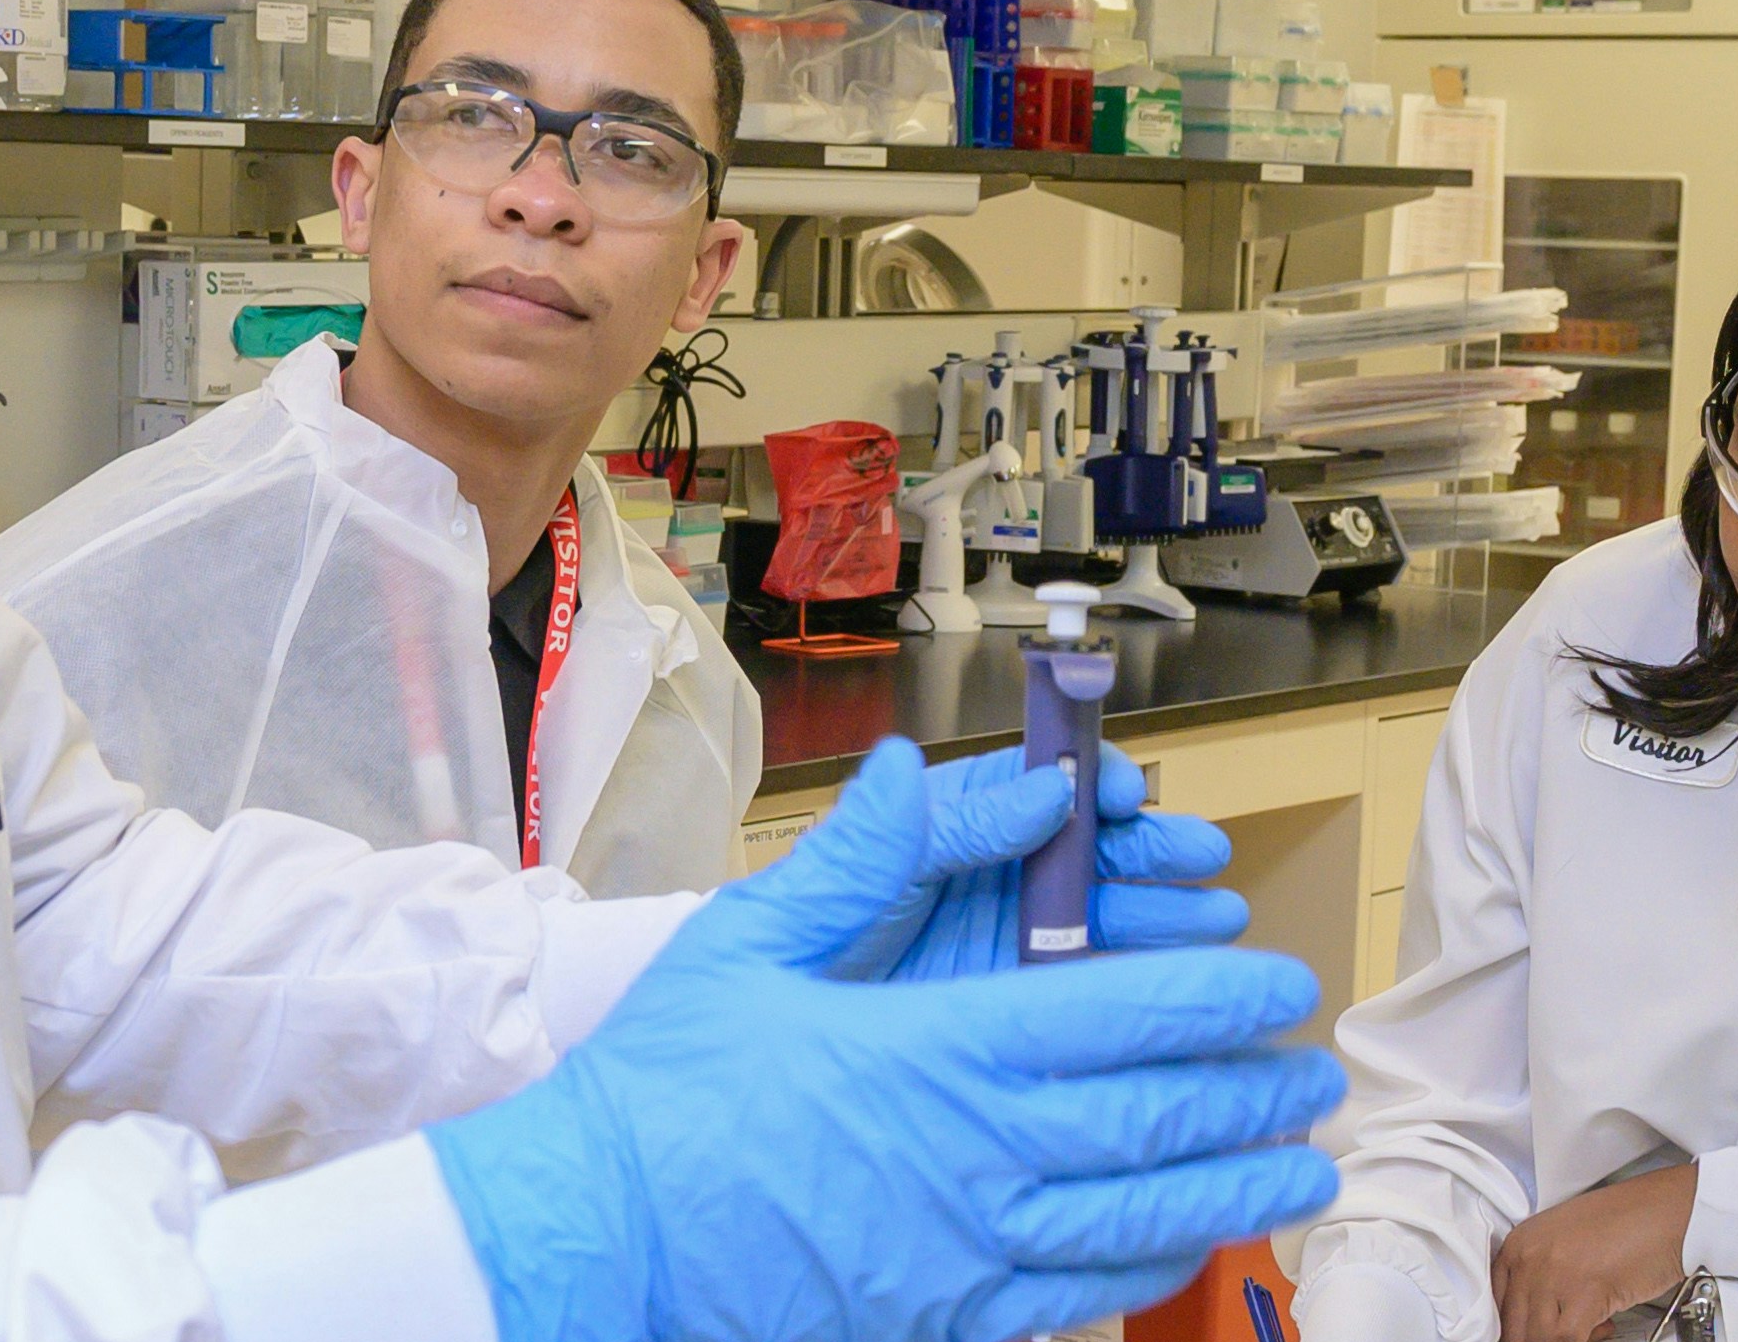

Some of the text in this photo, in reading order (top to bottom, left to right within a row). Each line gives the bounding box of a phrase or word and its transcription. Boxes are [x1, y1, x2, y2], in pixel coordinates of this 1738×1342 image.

[206, 271, 219, 295] S
[550, 504, 579, 653] VISITOR
[1613, 717, 1707, 767] Visitor
[744, 825, 808, 844] PIPETTE SUPPLIES
